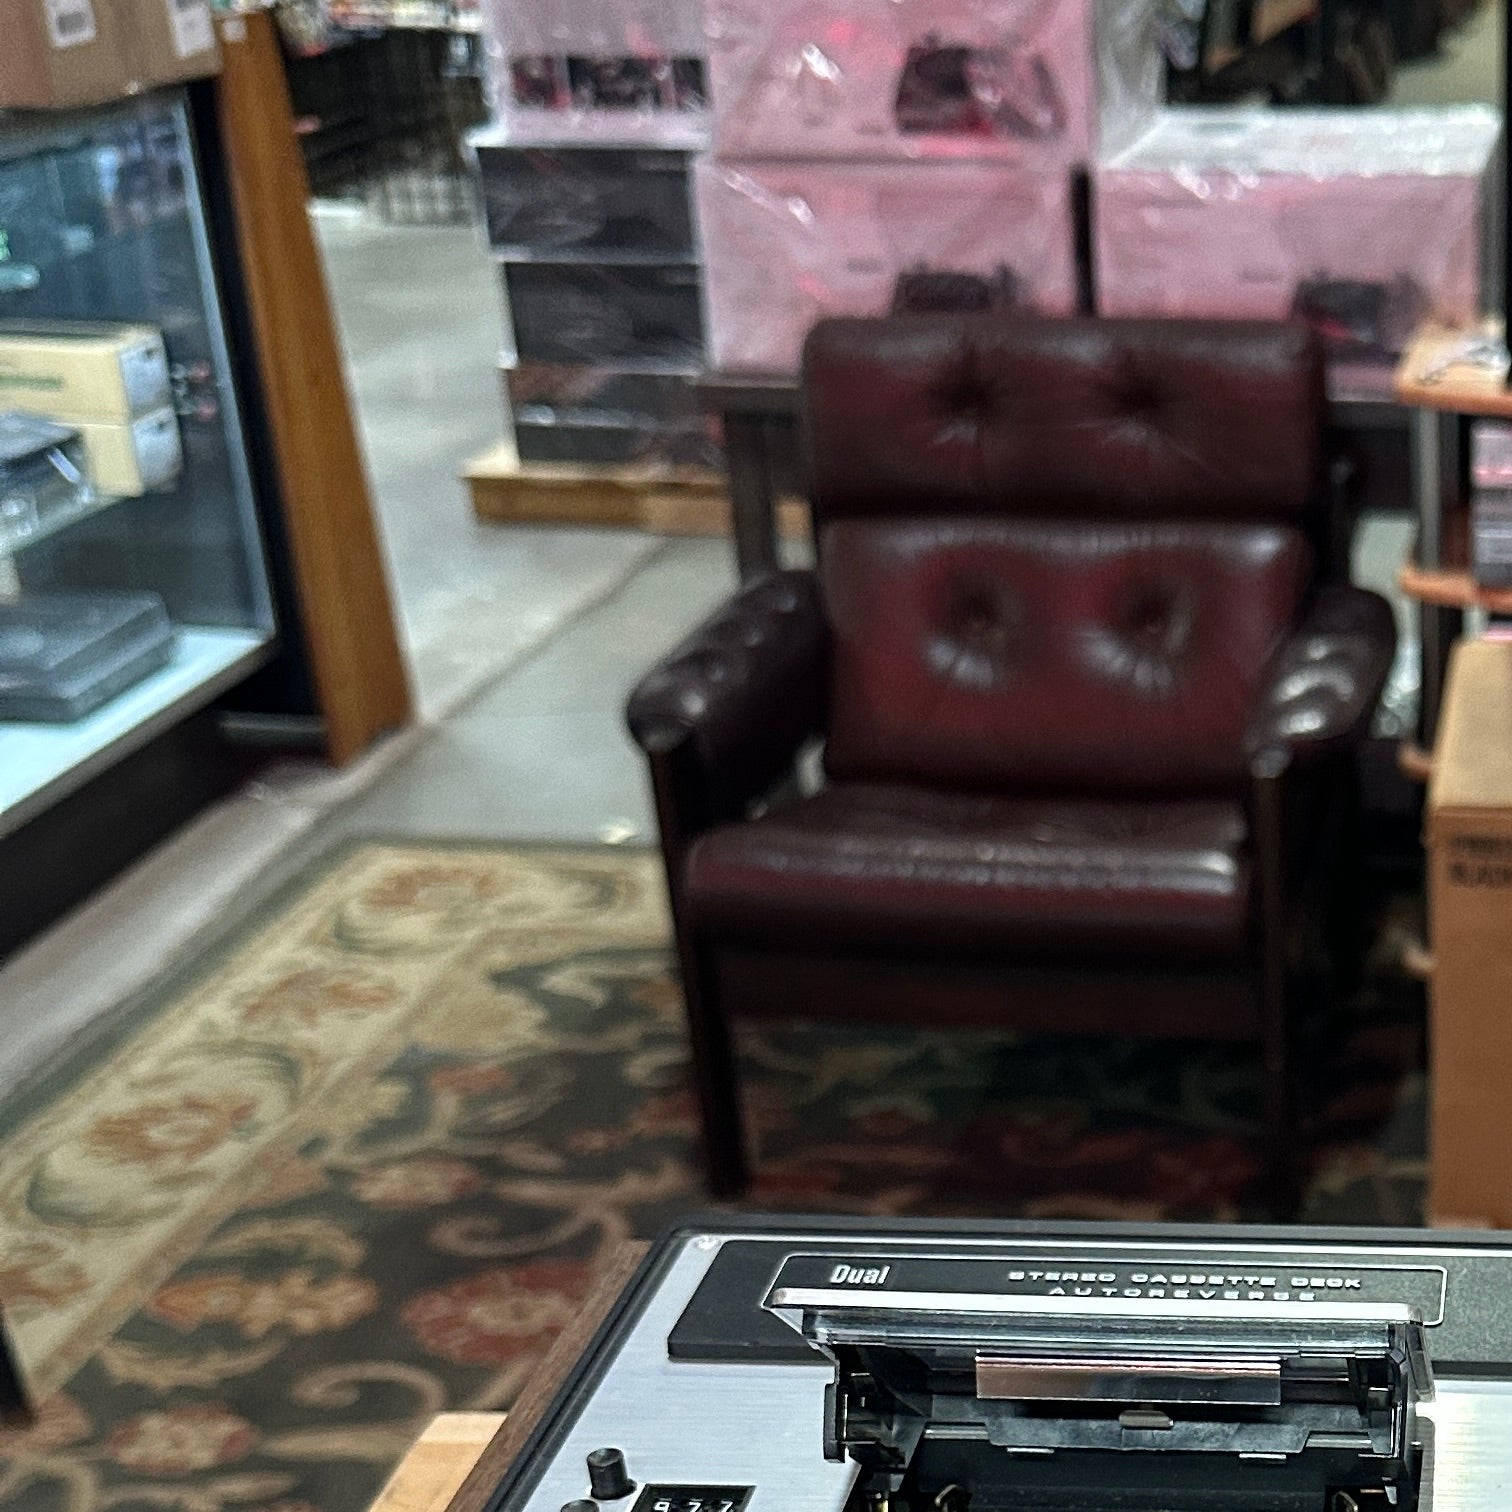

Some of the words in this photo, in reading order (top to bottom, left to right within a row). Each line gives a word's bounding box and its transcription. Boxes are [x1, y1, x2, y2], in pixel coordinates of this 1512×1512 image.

[830, 1264, 891, 1285] Dual
[1008, 1270, 1116, 1283] STEREO
[1131, 1273, 1276, 1287] CASSETTE
[1291, 1277, 1361, 1289] DECK
